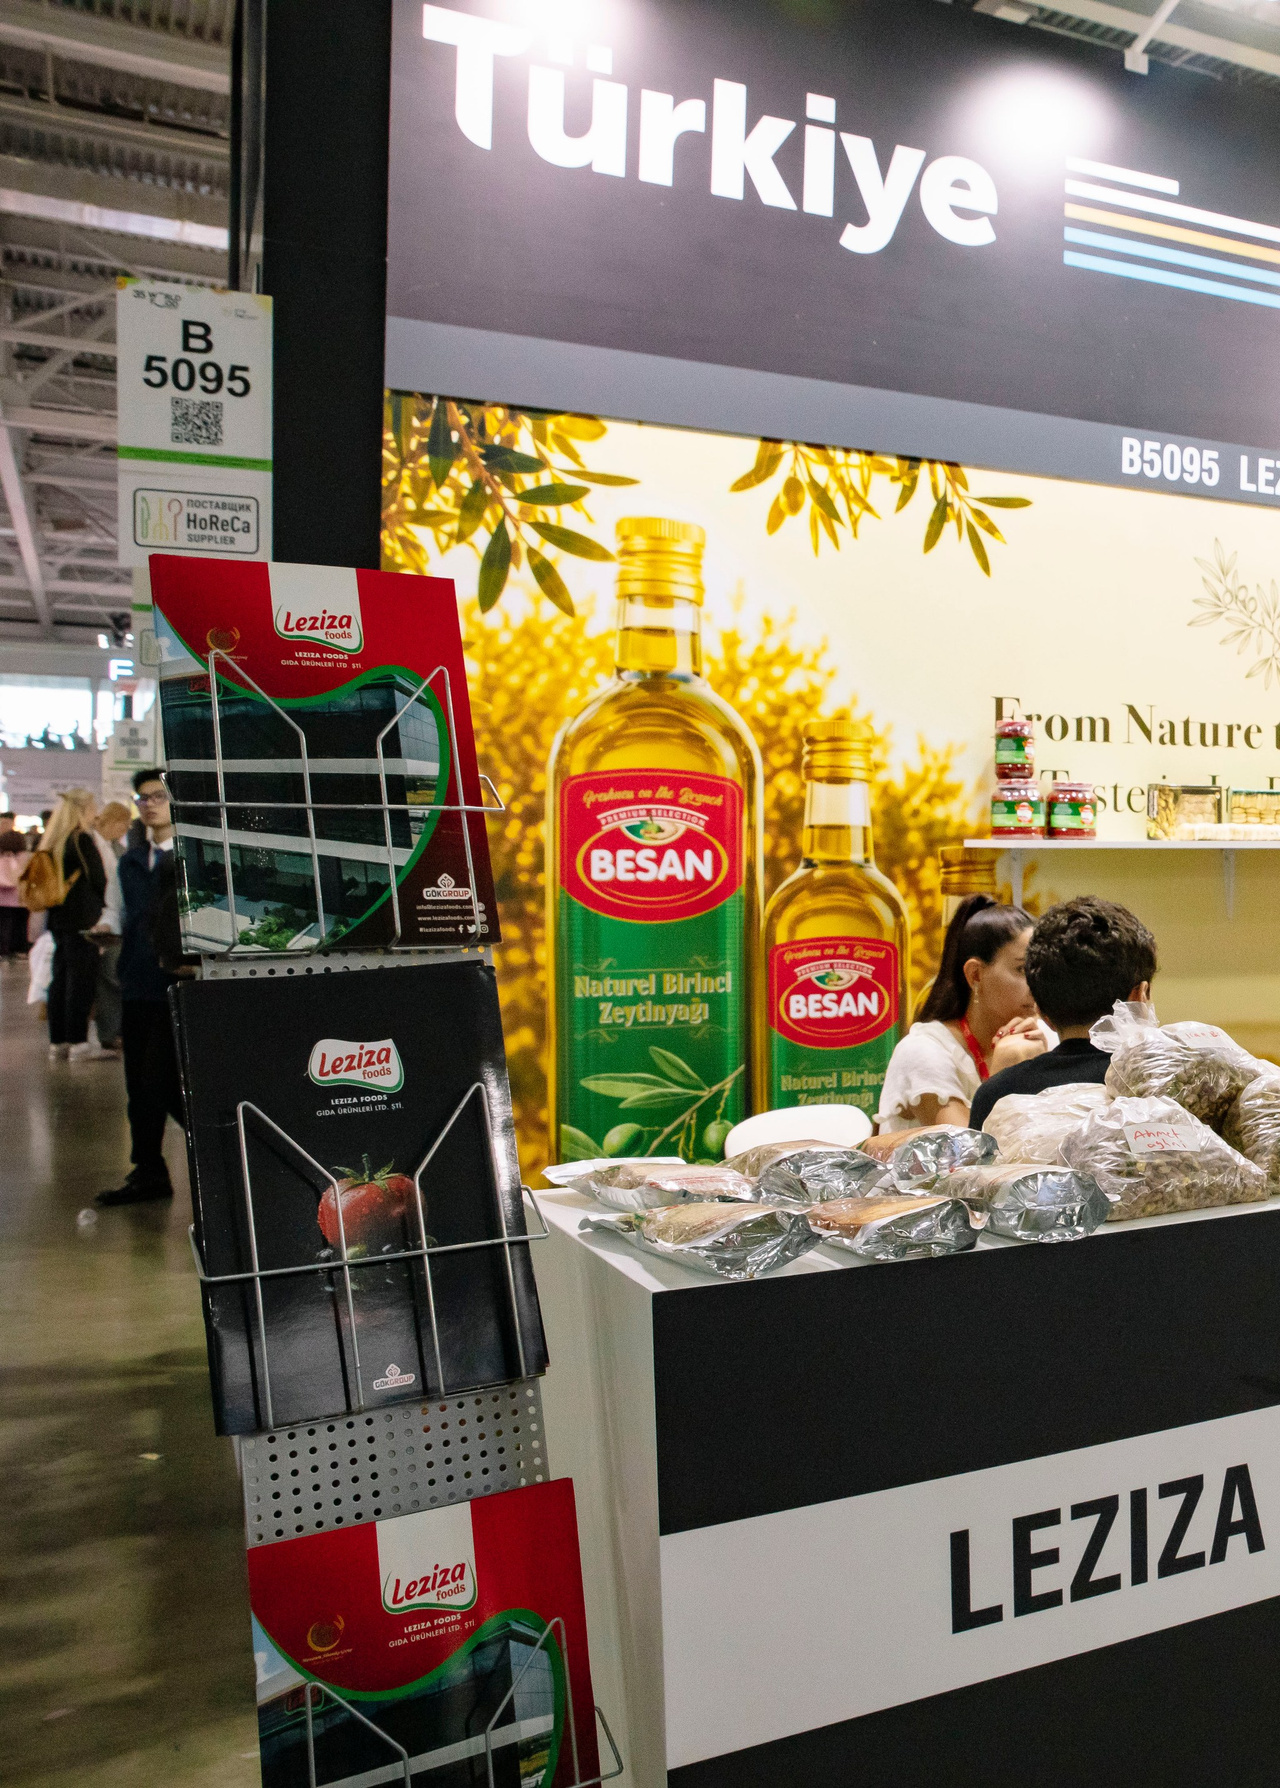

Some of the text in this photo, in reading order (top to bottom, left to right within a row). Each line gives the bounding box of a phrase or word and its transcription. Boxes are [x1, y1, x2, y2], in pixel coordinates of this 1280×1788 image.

[423, 3, 999, 254] Türkiye
[182, 319, 214, 354] B
[143, 354, 251, 397] 5095
[1121, 436, 1221, 487] B5095
[186, 498, 252, 512] ПОСТАВЩИК
[186, 512, 251, 534] HoReCa
[186, 533, 236, 545] SUPPLIER
[283, 609, 353, 632] Leziza
[325, 630, 353, 640] foods
[295, 651, 349, 660] LEZIZA FOODS
[1122, 703, 1264, 750] Nature
[600, 809, 706, 827] PREMIUM SELECTION
[590, 848, 714, 882] BESAN
[574, 971, 732, 998] Naturel Birinci
[599, 997, 709, 1029] Zeytinyağı
[789, 991, 880, 1020] BESAN
[319, 1044, 391, 1077] Leziza
[362, 1066, 392, 1080] foods
[781, 1072, 838, 1091] Naturel
[331, 1094, 388, 1105] LEZIZA FOODS
[316, 1109, 335, 1117] GIDA
[337, 1105, 373, 1115] ÜRÜNLERİ
[949, 1463, 1266, 1635] LEZIZA
[392, 1562, 466, 1606] Leziza
[436, 1583, 466, 1601] foods
[404, 1613, 462, 1634] LEZIZA FOODS
[388, 1637, 409, 1648] GIDA
[410, 1628, 446, 1643] ÜRÜNLERİ
